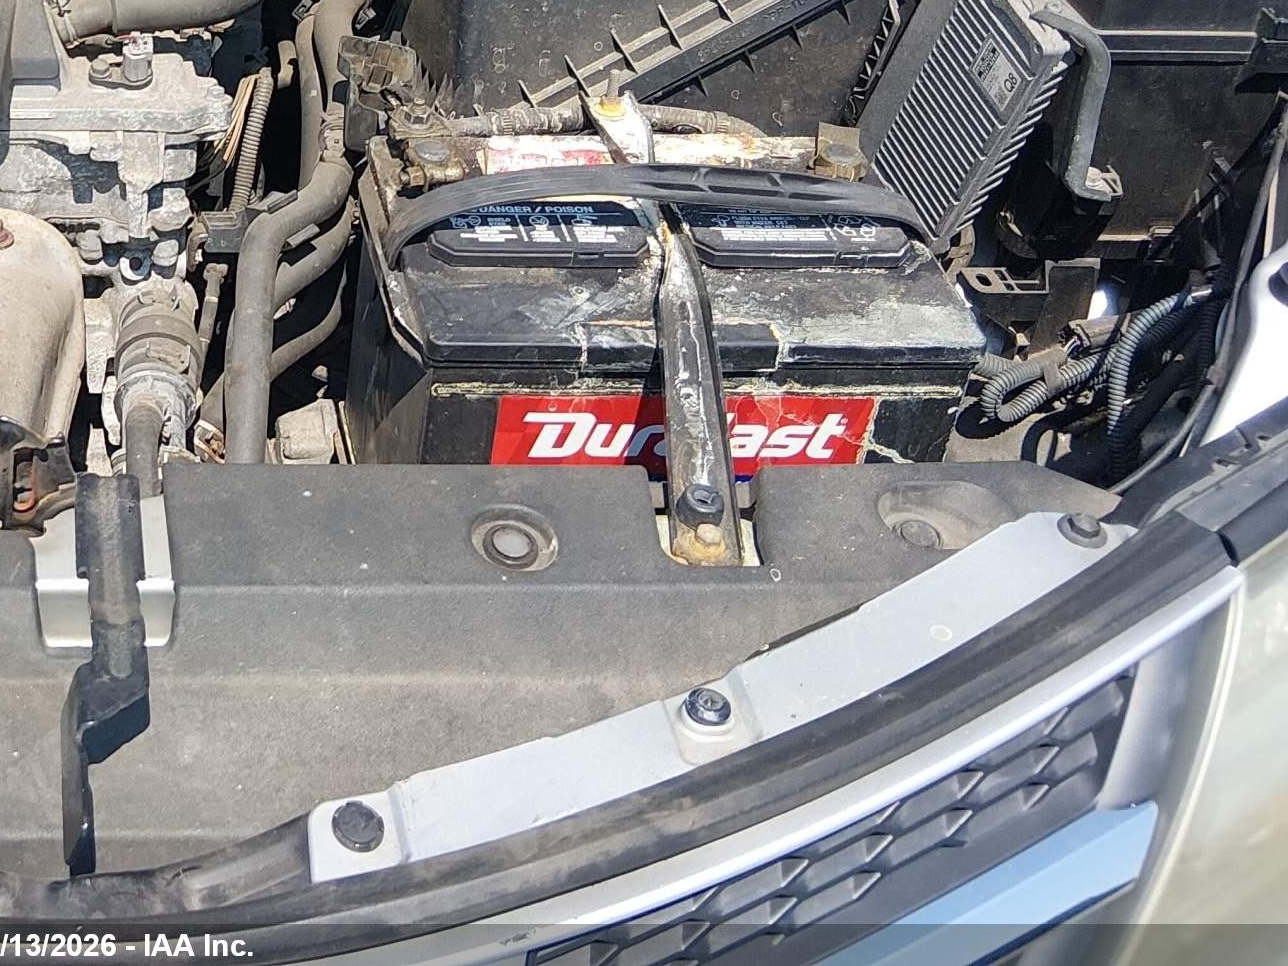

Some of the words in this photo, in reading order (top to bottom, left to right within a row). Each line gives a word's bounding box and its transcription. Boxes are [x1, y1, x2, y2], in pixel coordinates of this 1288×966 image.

[1003, 72, 1018, 93] Q8
[479, 205, 532, 213] DANGER
[545, 206, 594, 214] POISON
[523, 412, 848, 459] Durast
